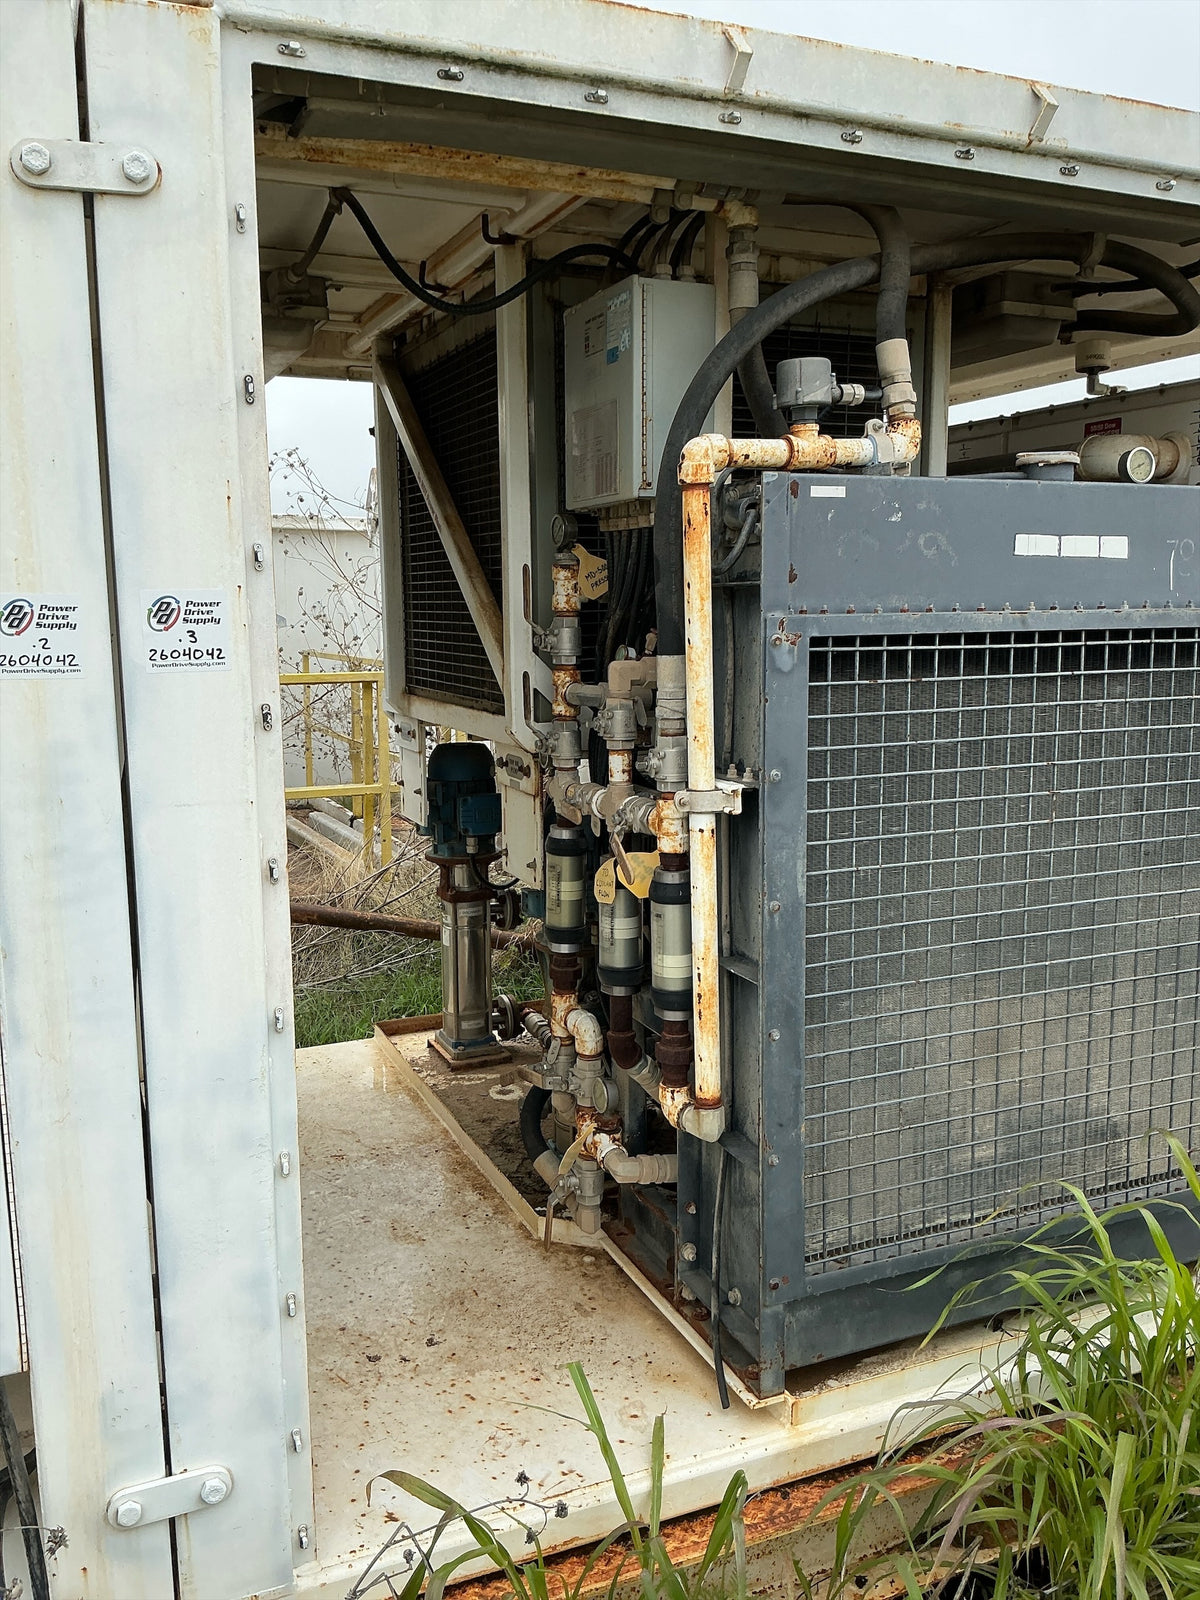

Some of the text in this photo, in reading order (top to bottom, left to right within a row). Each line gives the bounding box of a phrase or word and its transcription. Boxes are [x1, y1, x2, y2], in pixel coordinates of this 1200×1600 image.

[39, 604, 78, 612] Power
[185, 600, 222, 608] Power
[183, 608, 214, 616] Drive
[37, 613, 70, 621] Drive
[182, 616, 221, 625] Supply
[35, 621, 77, 631] Supply
[149, 647, 226, 661] 2604042
[0, 653, 80, 667] 2604042
[151, 661, 226, 669] PowerDriveSupply.com
